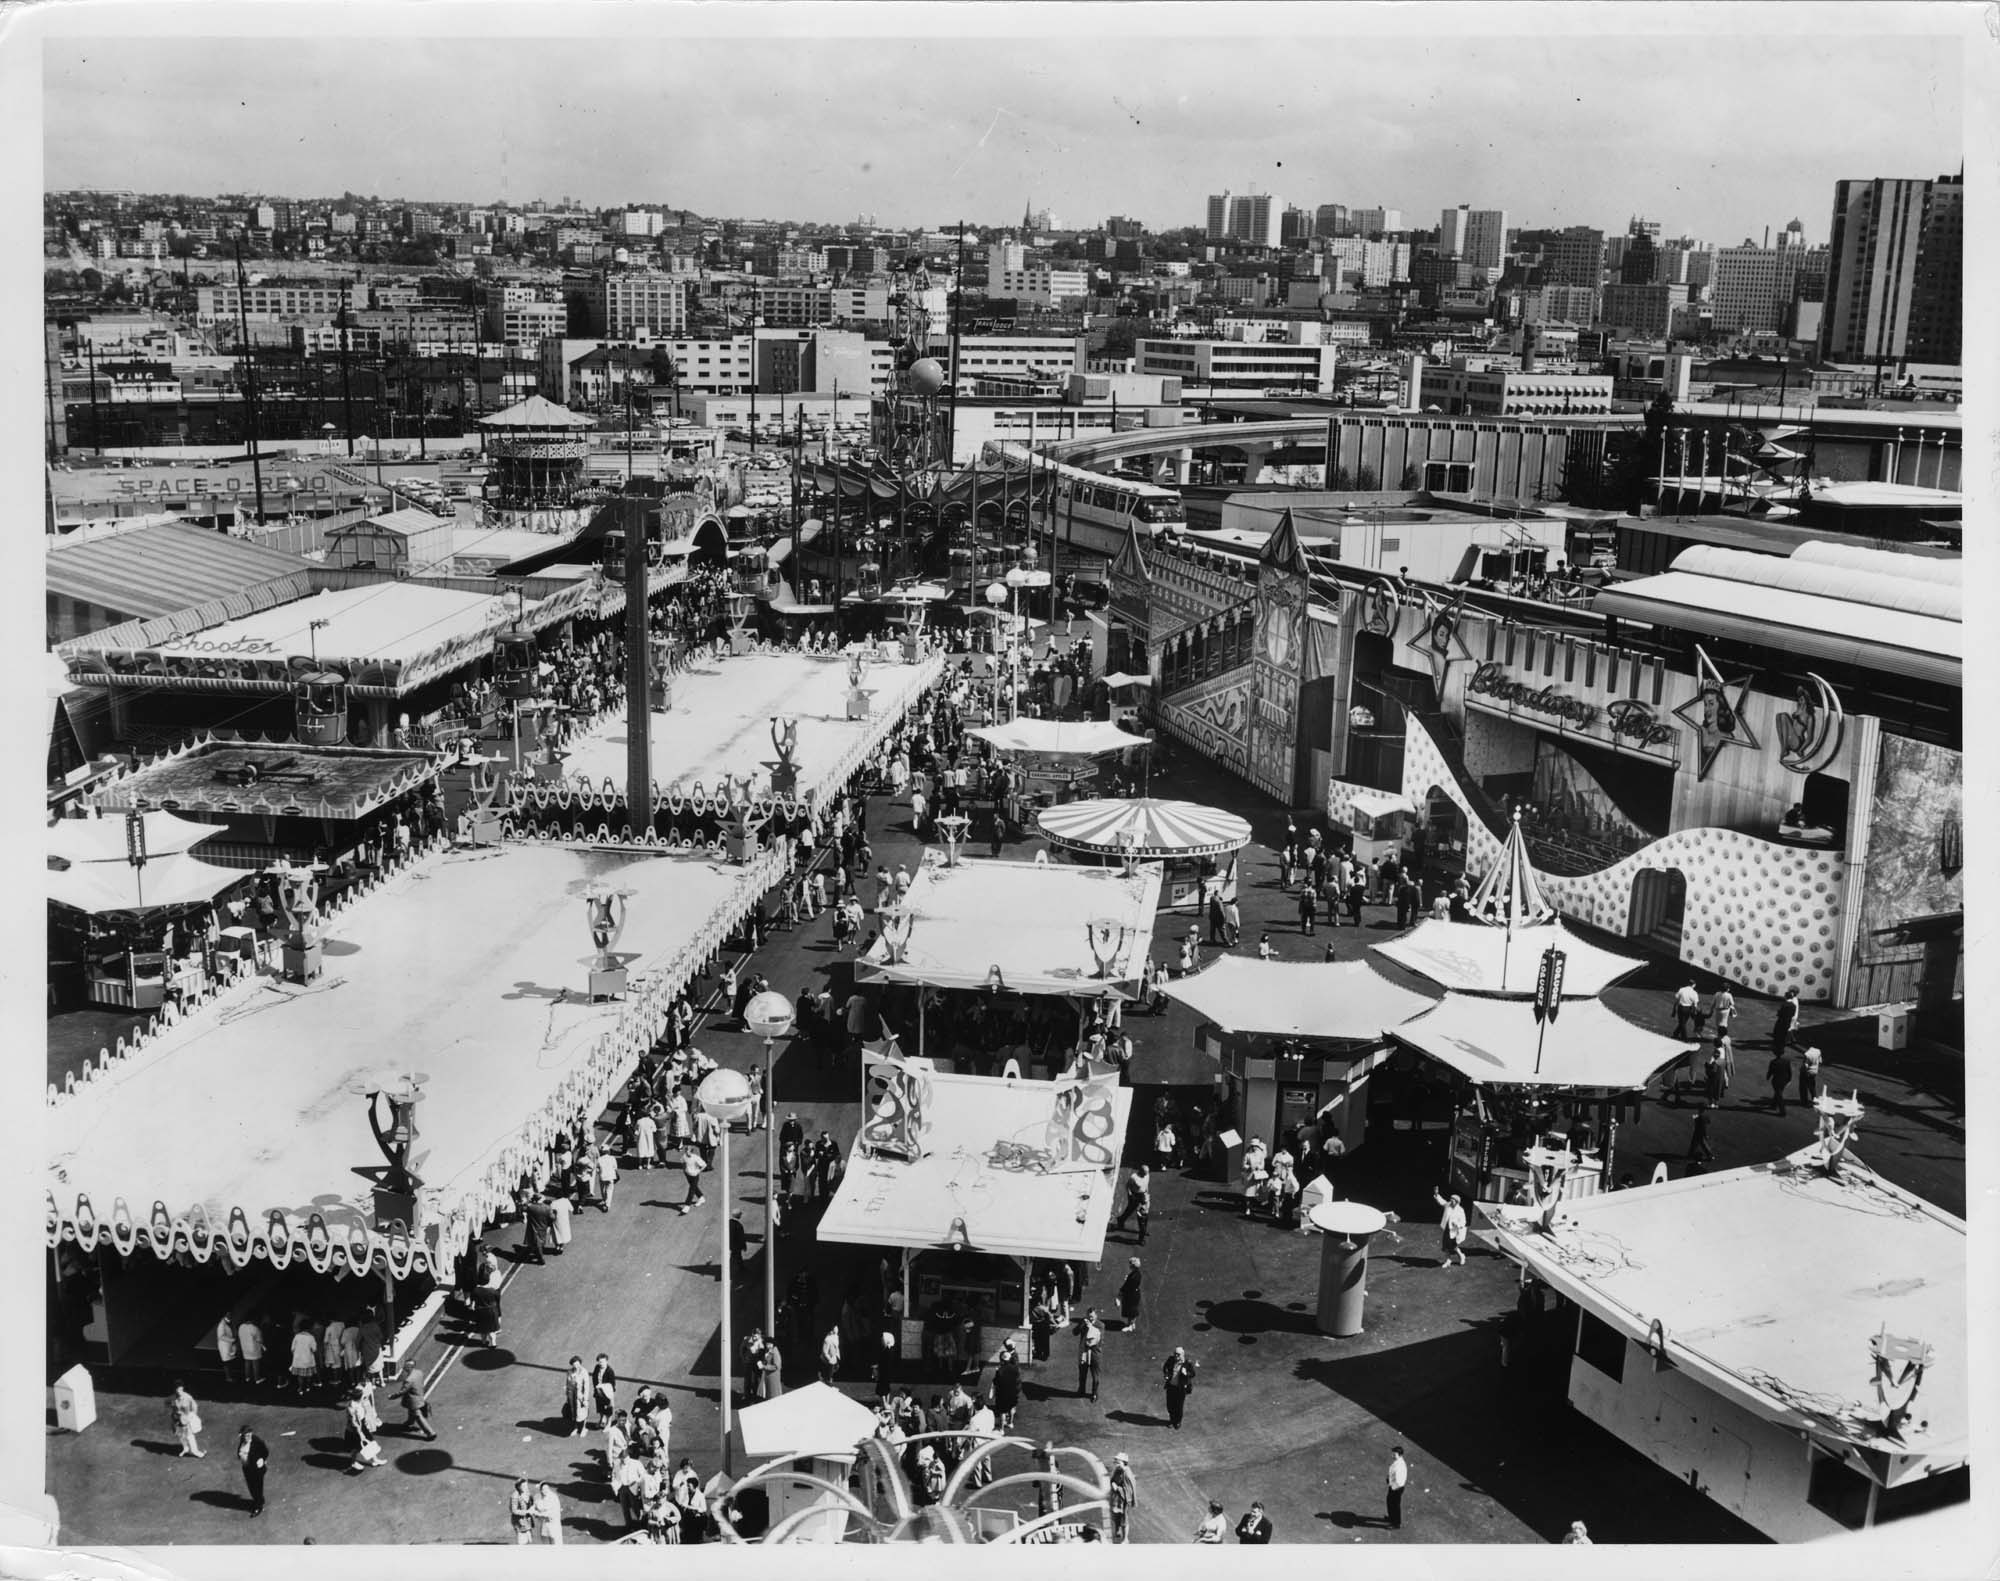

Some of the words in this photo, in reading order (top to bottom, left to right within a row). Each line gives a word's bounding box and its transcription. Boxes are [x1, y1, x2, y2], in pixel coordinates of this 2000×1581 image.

[164, 631, 282, 654] Shooter
[1537, 958, 1547, 1007] POPCORN
[1550, 959, 1563, 1008] POPCORN
